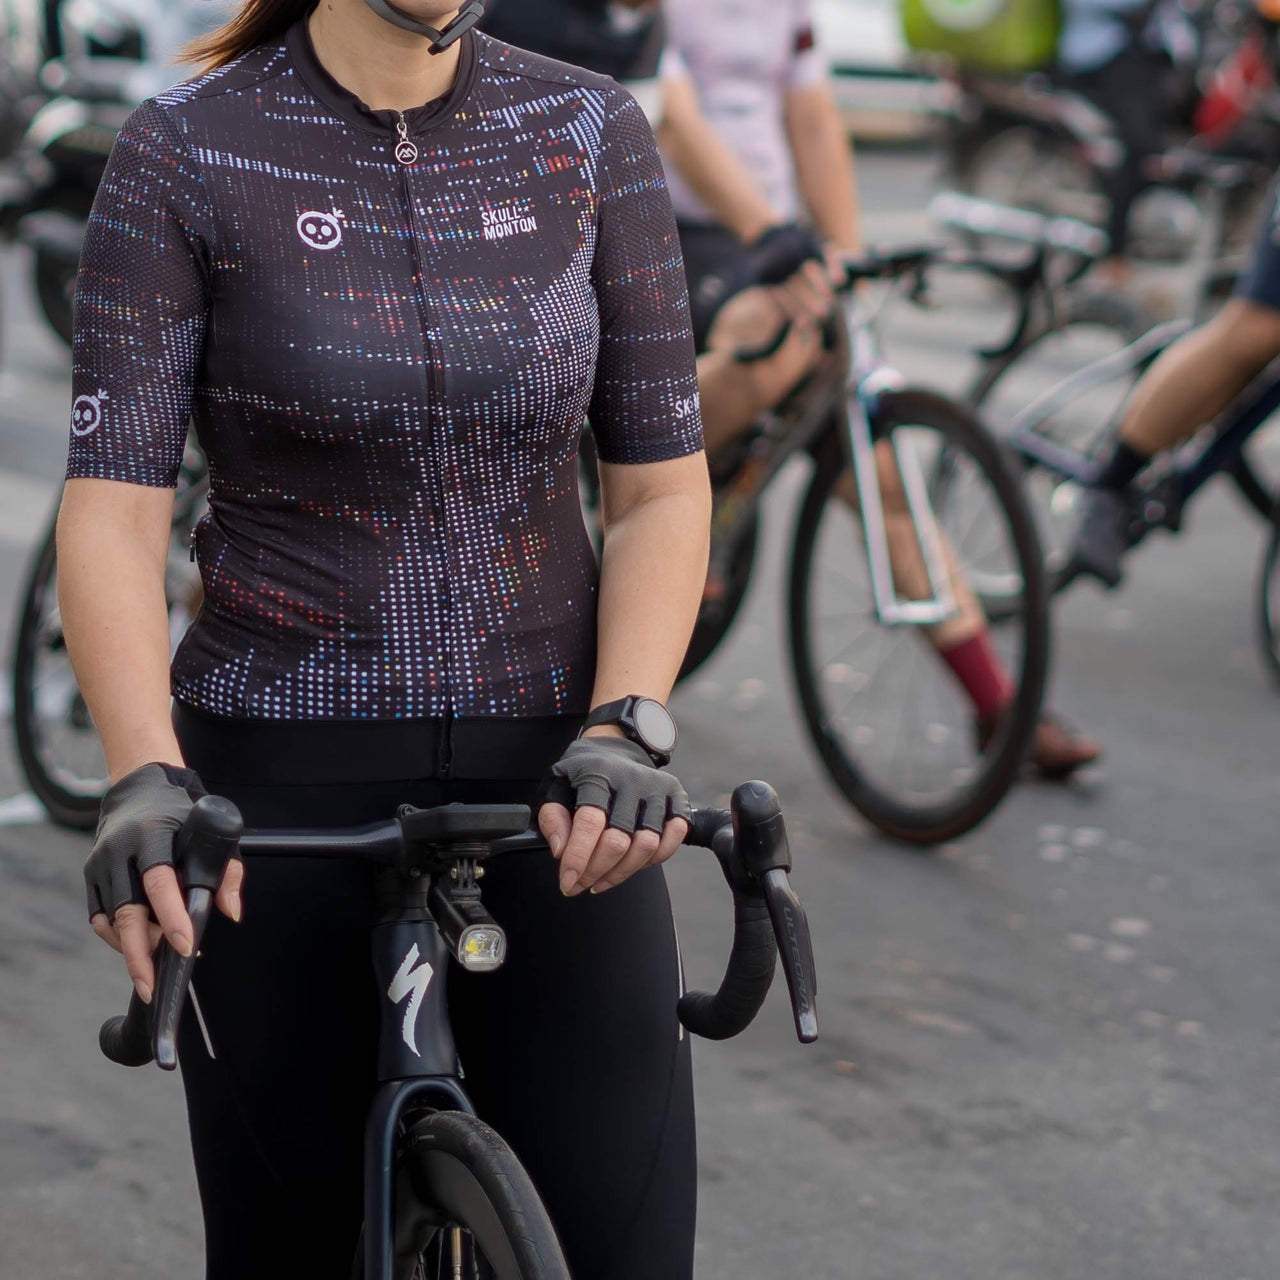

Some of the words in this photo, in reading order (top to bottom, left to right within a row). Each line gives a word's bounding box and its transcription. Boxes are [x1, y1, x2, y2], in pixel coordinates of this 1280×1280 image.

[481, 205, 521, 226] SKULL
[483, 216, 537, 240] MONTON
[166, 958, 187, 1033] TEGRA
